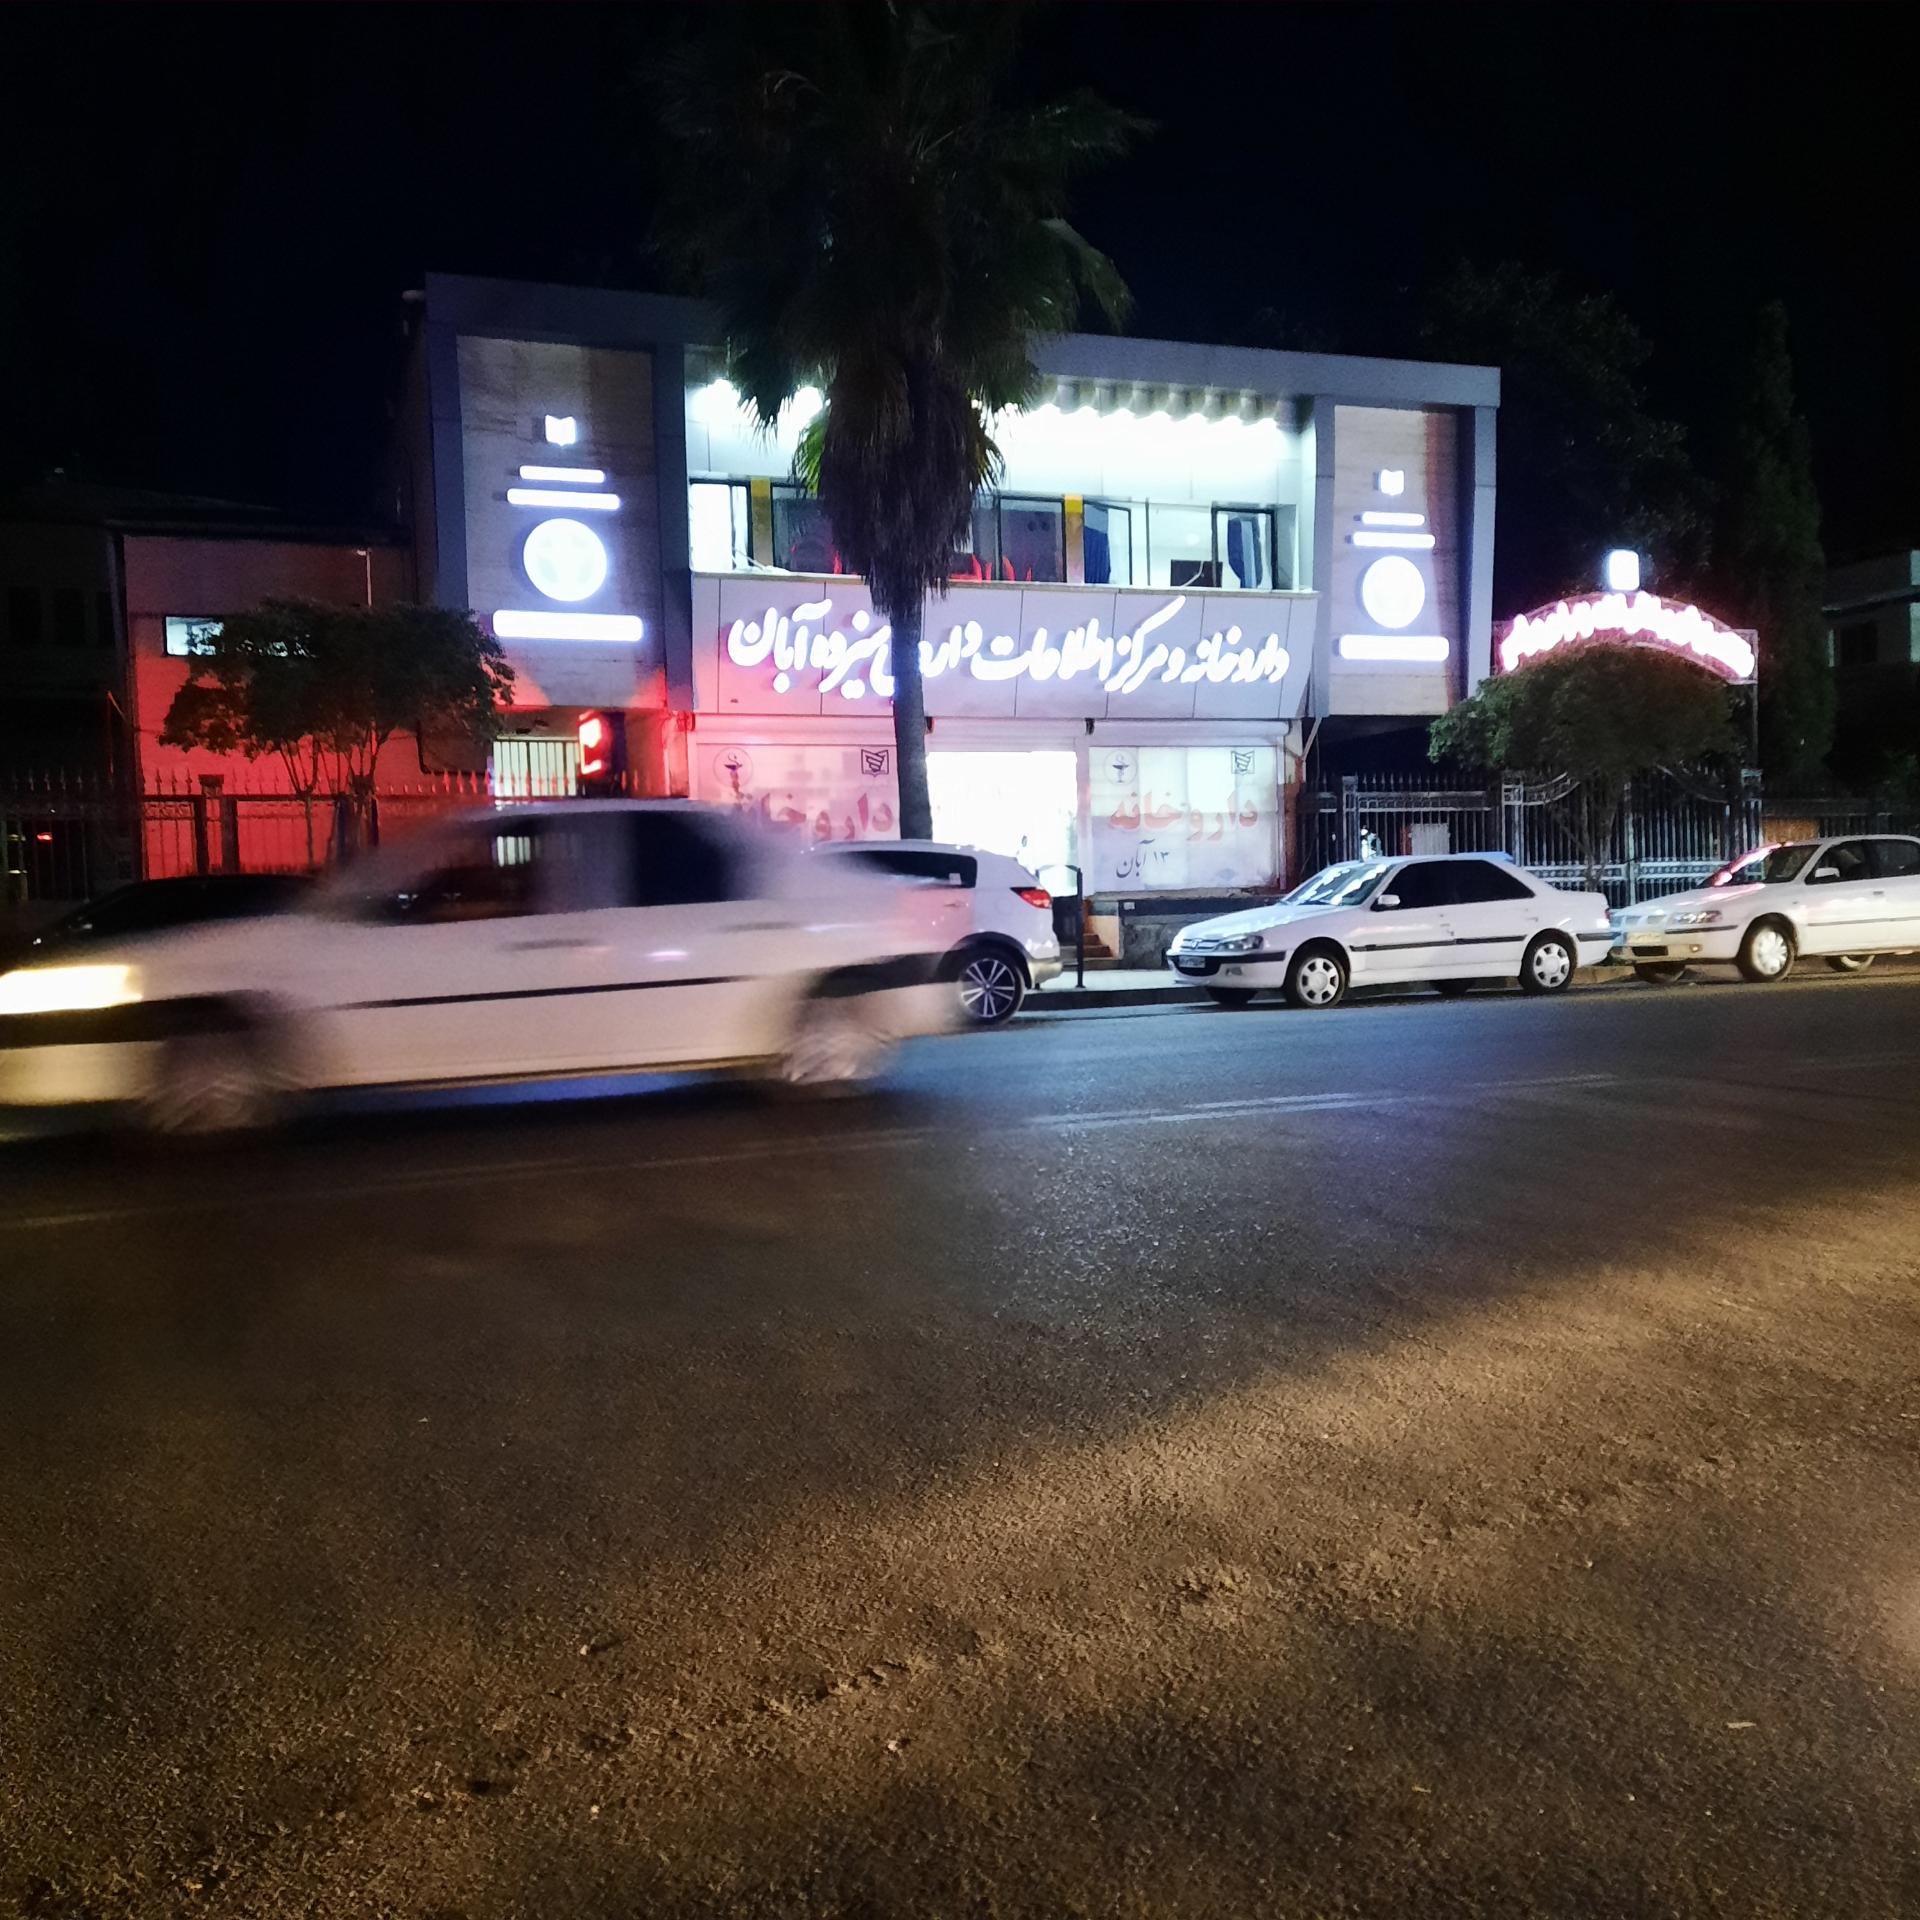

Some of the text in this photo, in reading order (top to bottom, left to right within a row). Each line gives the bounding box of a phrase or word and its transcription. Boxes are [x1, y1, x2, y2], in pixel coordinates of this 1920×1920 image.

[727, 598, 833, 694] آبان
[970, 617, 1115, 681] اطلاعات
[1104, 595, 1186, 694] مرکز
[1161, 646, 1186, 683] و
[1180, 625, 1290, 683] داروخانه
[1108, 788, 1259, 842] داروخانه
[1115, 838, 1156, 879] آبان
